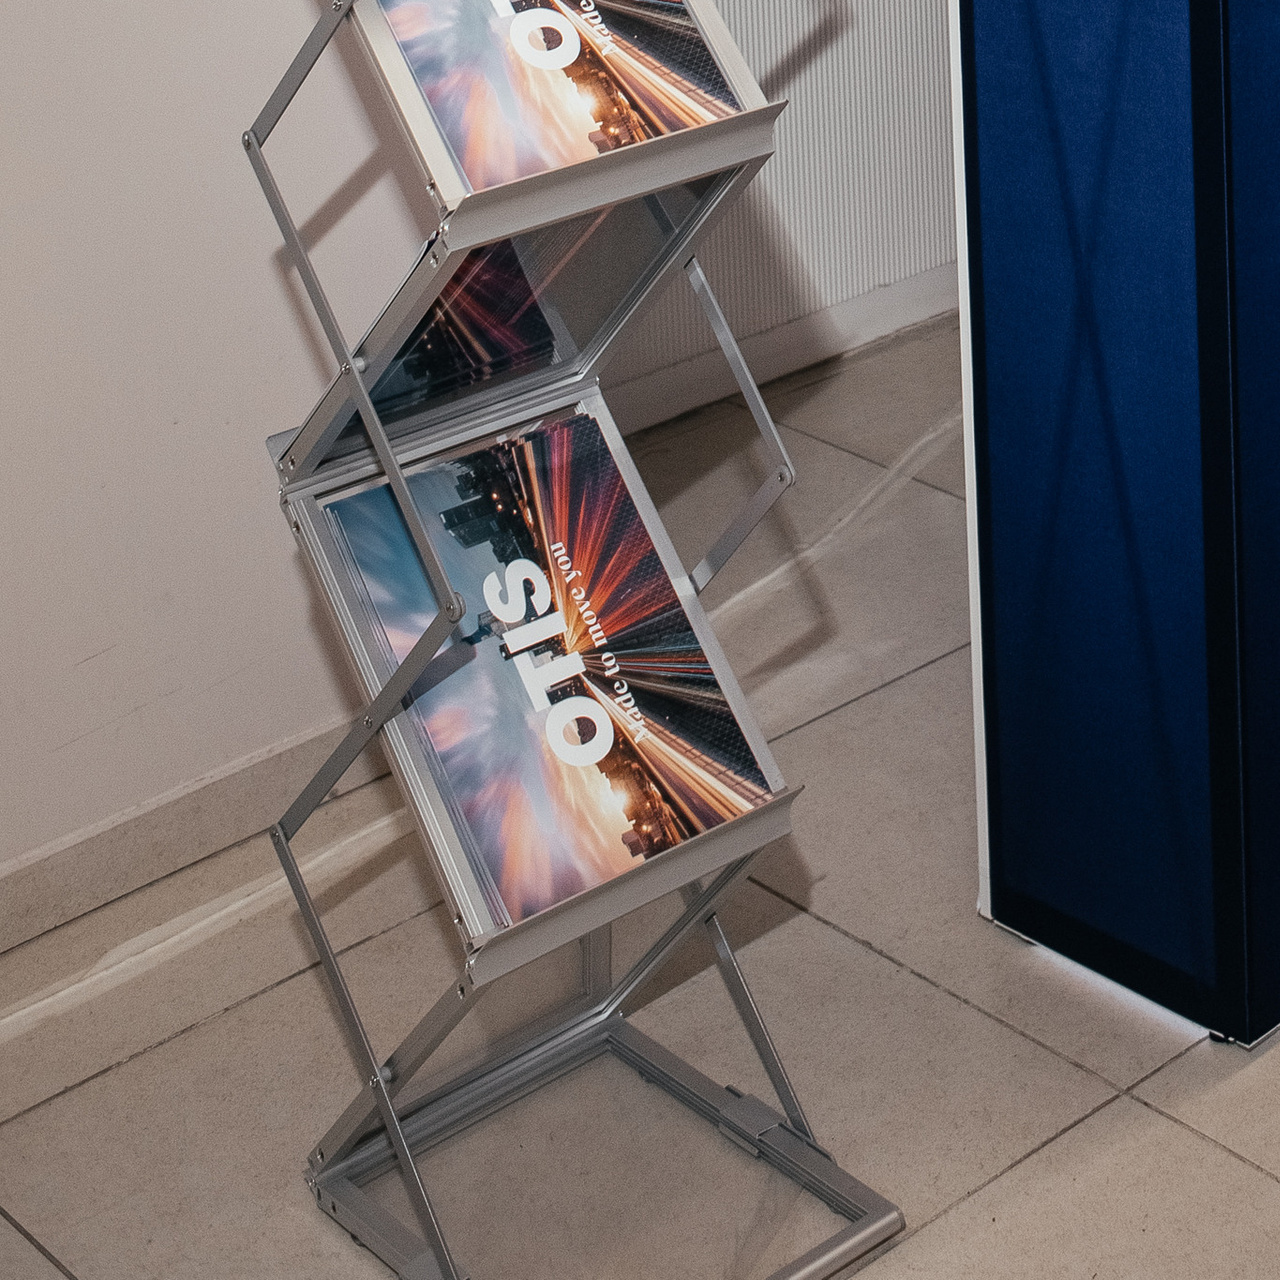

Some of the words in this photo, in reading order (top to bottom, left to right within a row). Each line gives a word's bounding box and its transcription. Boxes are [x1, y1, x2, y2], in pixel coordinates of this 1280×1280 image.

[550, 541, 583, 584] you
[571, 586, 609, 649] move
[482, 557, 615, 768] OTIS
[600, 651, 621, 678] to
[613, 679, 653, 744] Made
